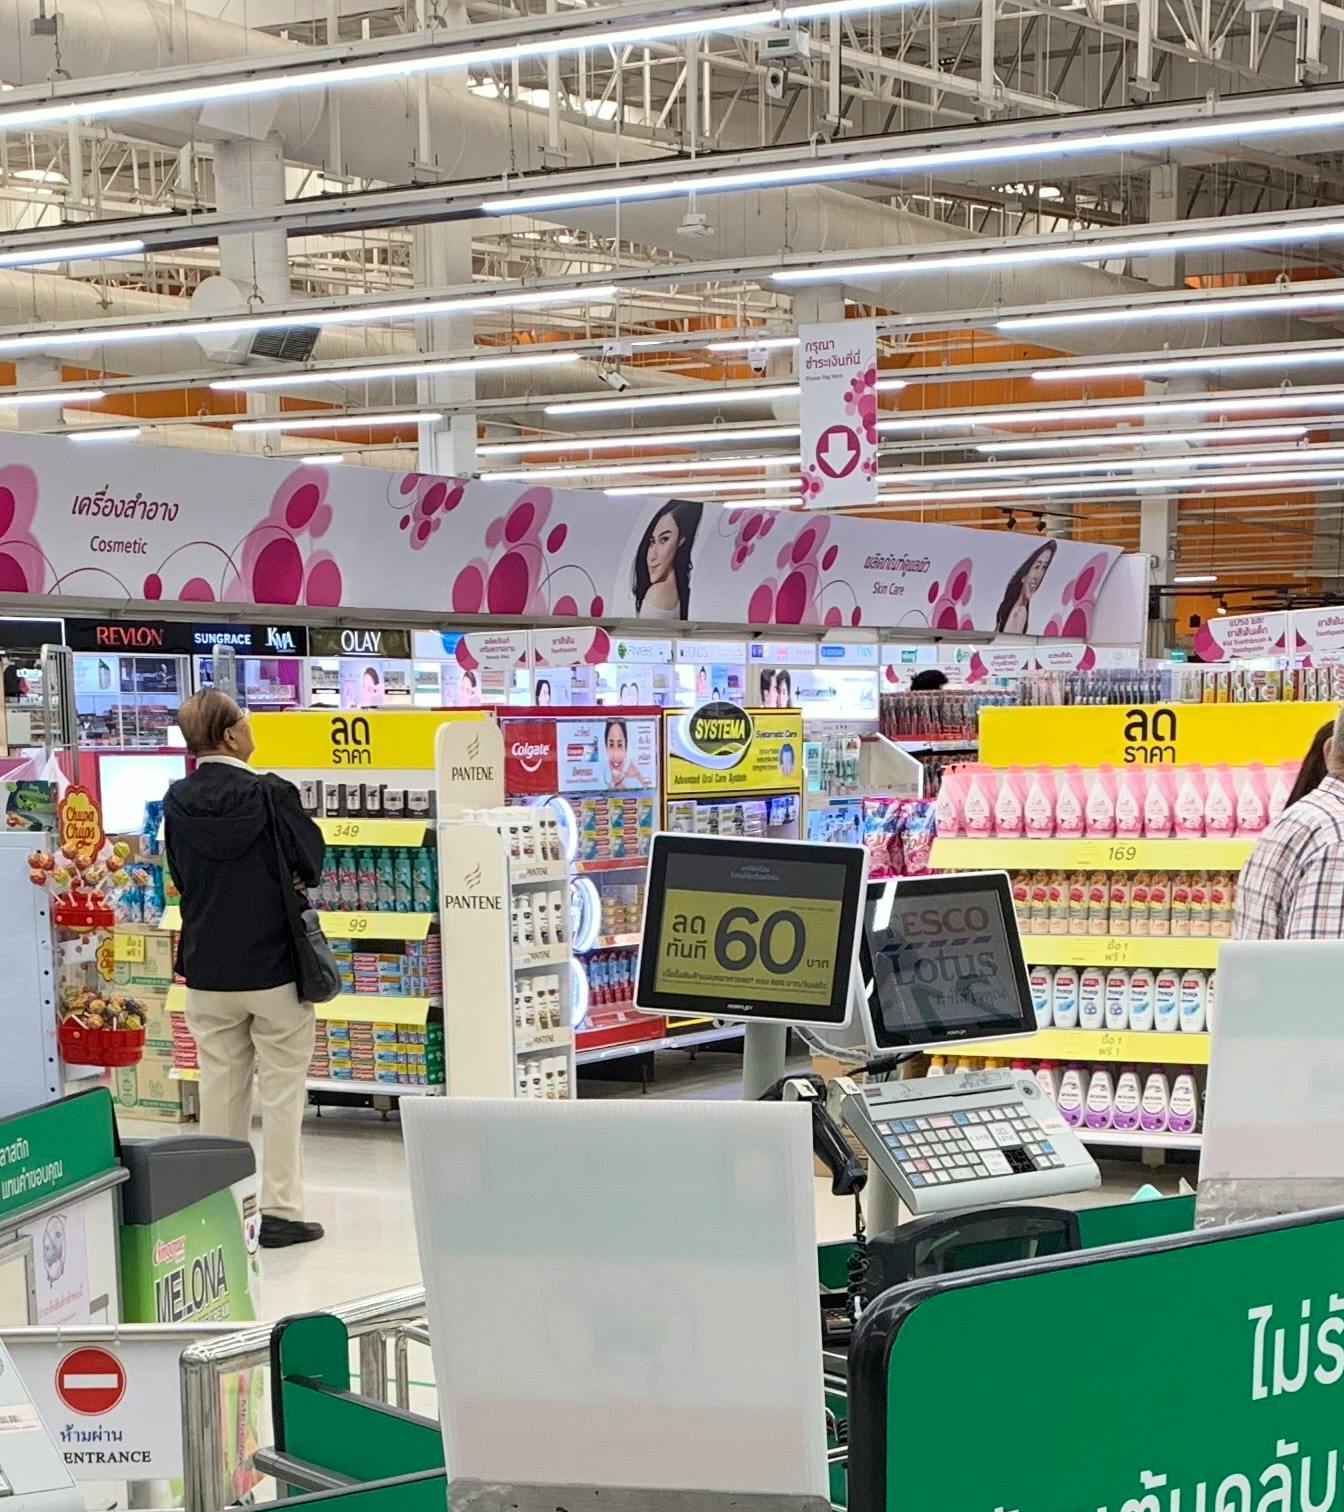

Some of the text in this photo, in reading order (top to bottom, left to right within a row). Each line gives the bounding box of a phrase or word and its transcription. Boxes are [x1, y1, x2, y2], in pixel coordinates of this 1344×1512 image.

[805, 340, 835, 354] กรุณา
[72, 484, 179, 522] เครื่องสำอาง
[90, 536, 147, 555] Cosmetic
[872, 582, 904, 597] Skin Care
[96, 626, 163, 646] REVLON
[194, 632, 252, 645] SUNGRACE
[265, 627, 296, 650] KMA
[341, 630, 381, 651] OLAY
[331, 717, 370, 746] ลด
[694, 719, 745, 740] SYSTEMA
[1124, 709, 1176, 742] ลด
[333, 748, 371, 765] ราคา
[511, 742, 550, 759] Colgate
[1124, 745, 1176, 764] ราคา
[452, 766, 493, 781] PANTENE
[66, 807, 94, 822] Chupa
[66, 822, 95, 839] Chups
[334, 825, 359, 838] 349
[1109, 846, 1136, 861] 169
[445, 895, 502, 910] PANTENE
[348, 919, 367, 932] 99
[672, 914, 705, 934] ลด
[666, 938, 707, 960] ทันที
[714, 907, 805, 975] 60
[807, 958, 829, 968] บาท
[889, 947, 998, 986] Lotus
[155, 1245, 229, 1322] MELONA
[60, 1424, 123, 1443] ห้ามผ่าน
[64, 1450, 152, 1464] ENTRANCE
